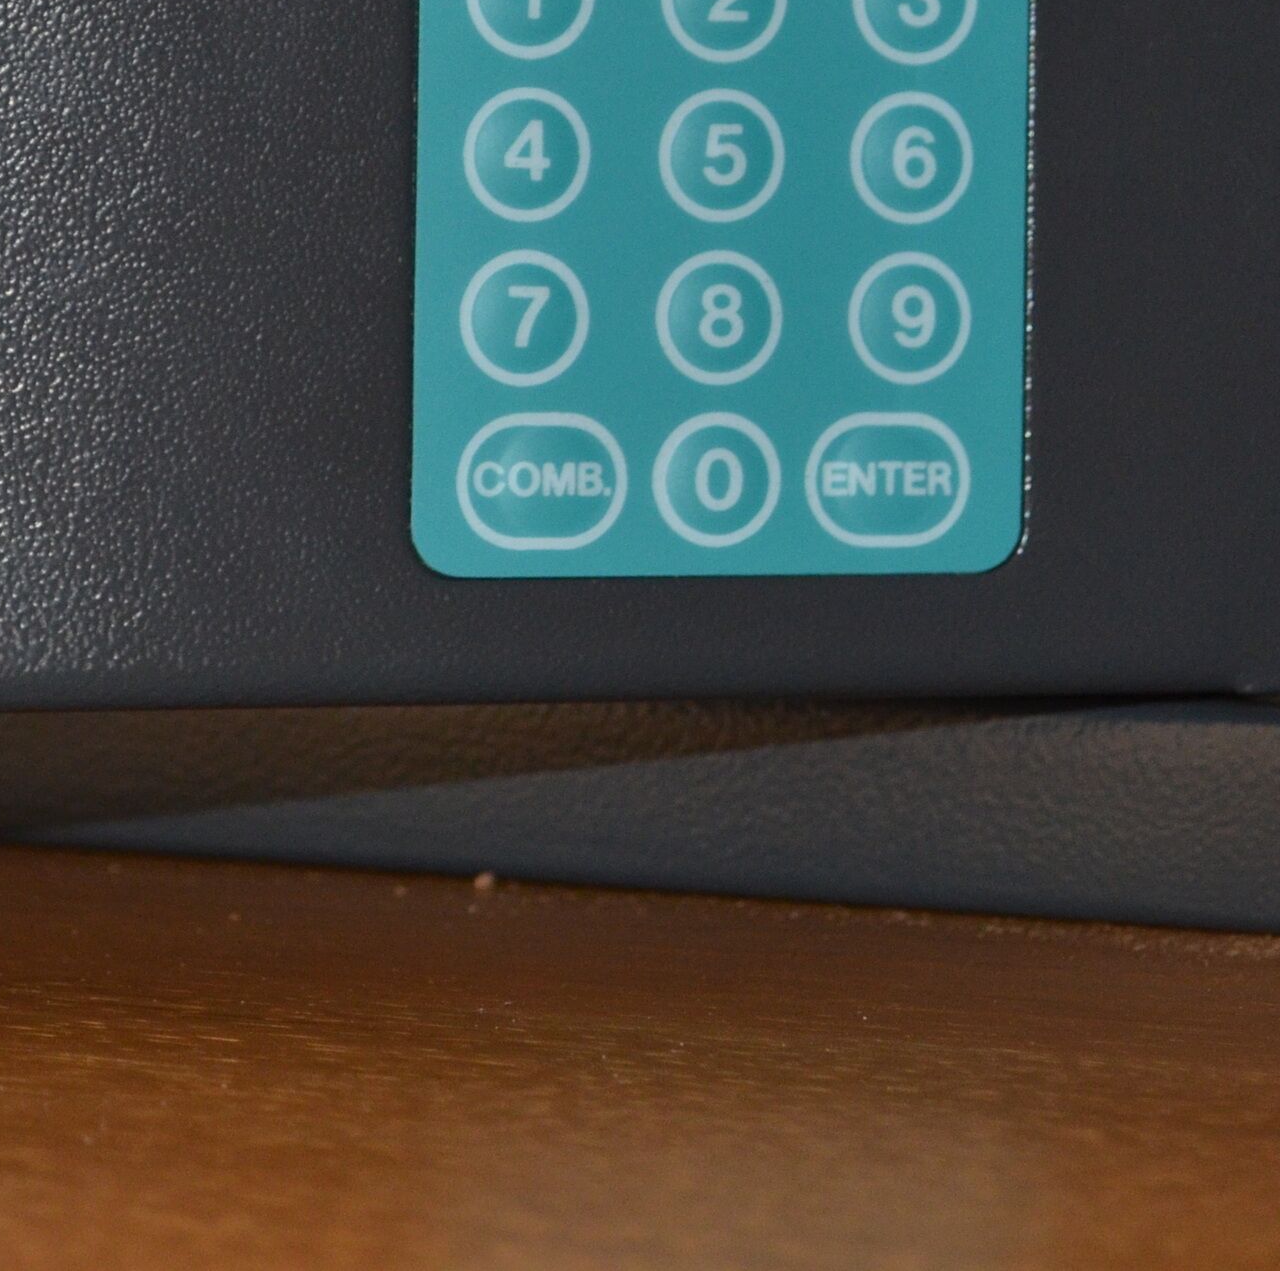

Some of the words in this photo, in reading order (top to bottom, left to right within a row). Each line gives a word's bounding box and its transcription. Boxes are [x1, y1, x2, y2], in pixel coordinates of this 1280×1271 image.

[504, 119, 550, 181] 4
[702, 124, 747, 186] 5
[892, 125, 936, 188] 6
[507, 286, 550, 347] 7
[699, 283, 744, 347] 8
[891, 286, 935, 347] 9
[472, 461, 612, 497] COMB.
[695, 447, 743, 511] 0
[823, 461, 952, 496] ENTER
